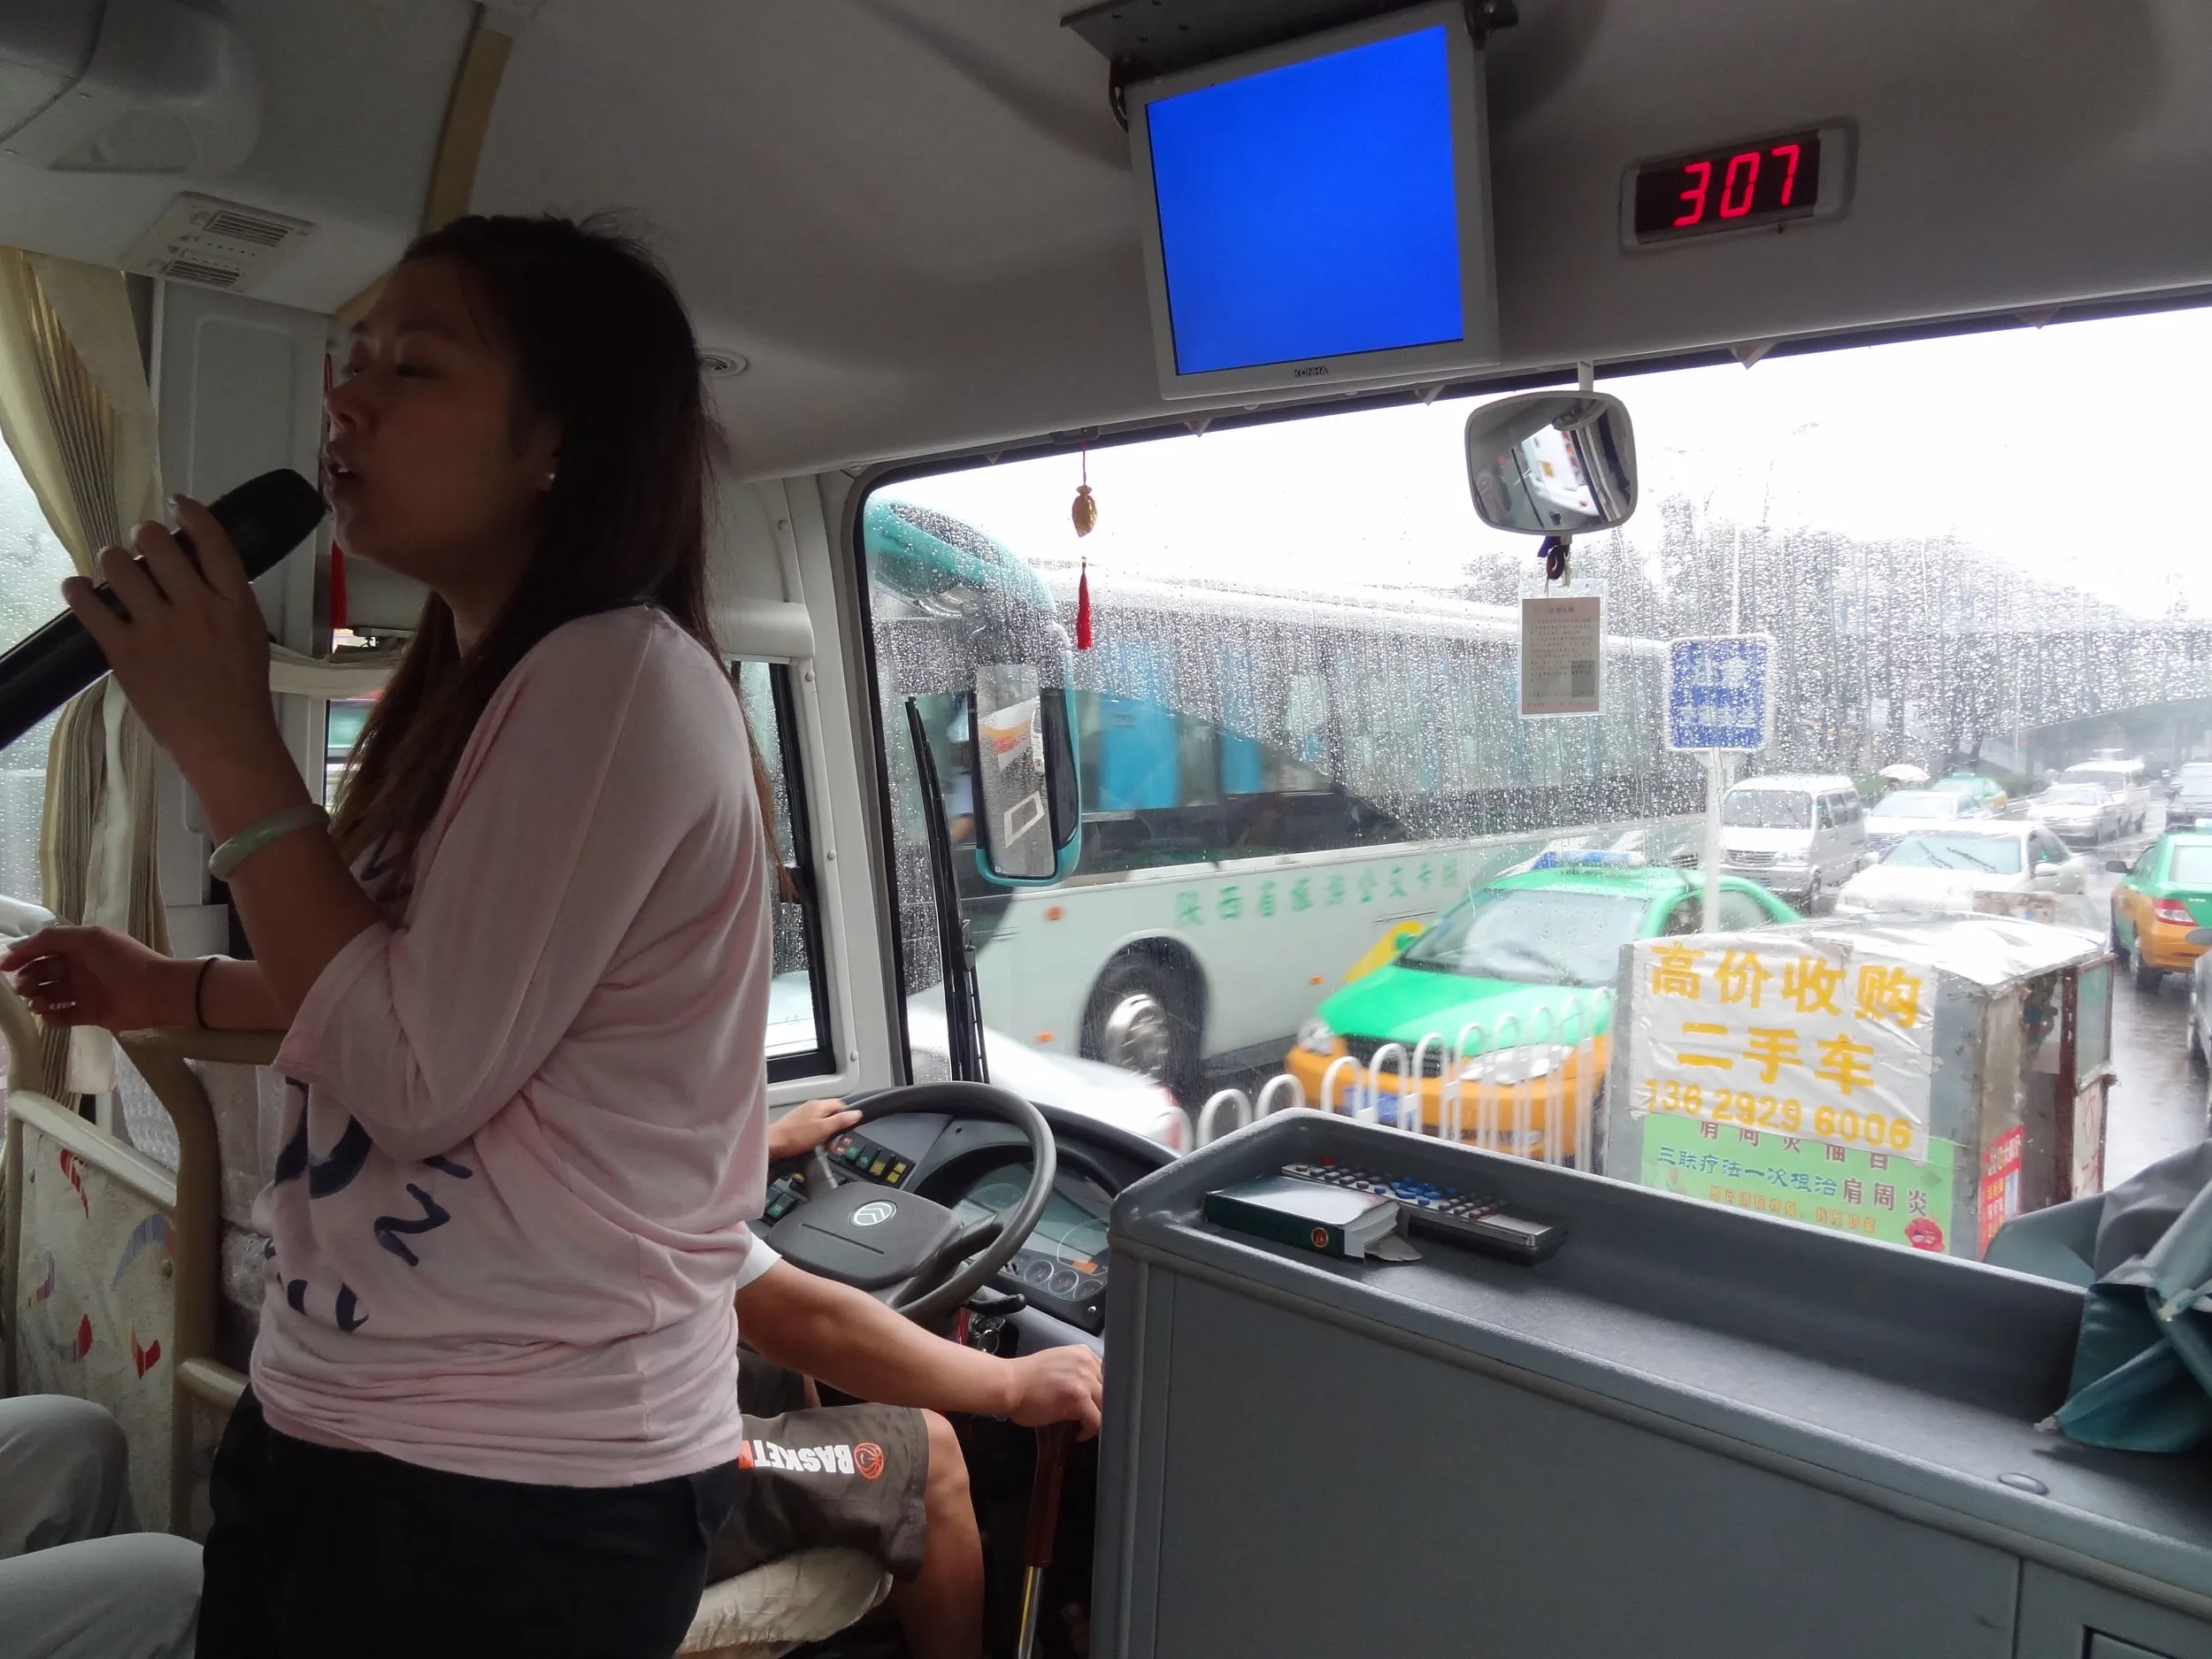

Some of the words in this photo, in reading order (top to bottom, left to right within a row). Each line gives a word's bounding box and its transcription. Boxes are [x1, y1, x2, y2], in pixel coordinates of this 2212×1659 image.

[1672, 143, 1801, 227] 307
[1651, 941, 1923, 1027] 高价收购
[1677, 1022, 1876, 1095] 二手车
[1646, 1078, 1703, 1115] 136
[1712, 1088, 1801, 1133] 2929
[1814, 1106, 1913, 1151] 6006
[753, 1440, 856, 1474] BASKET
